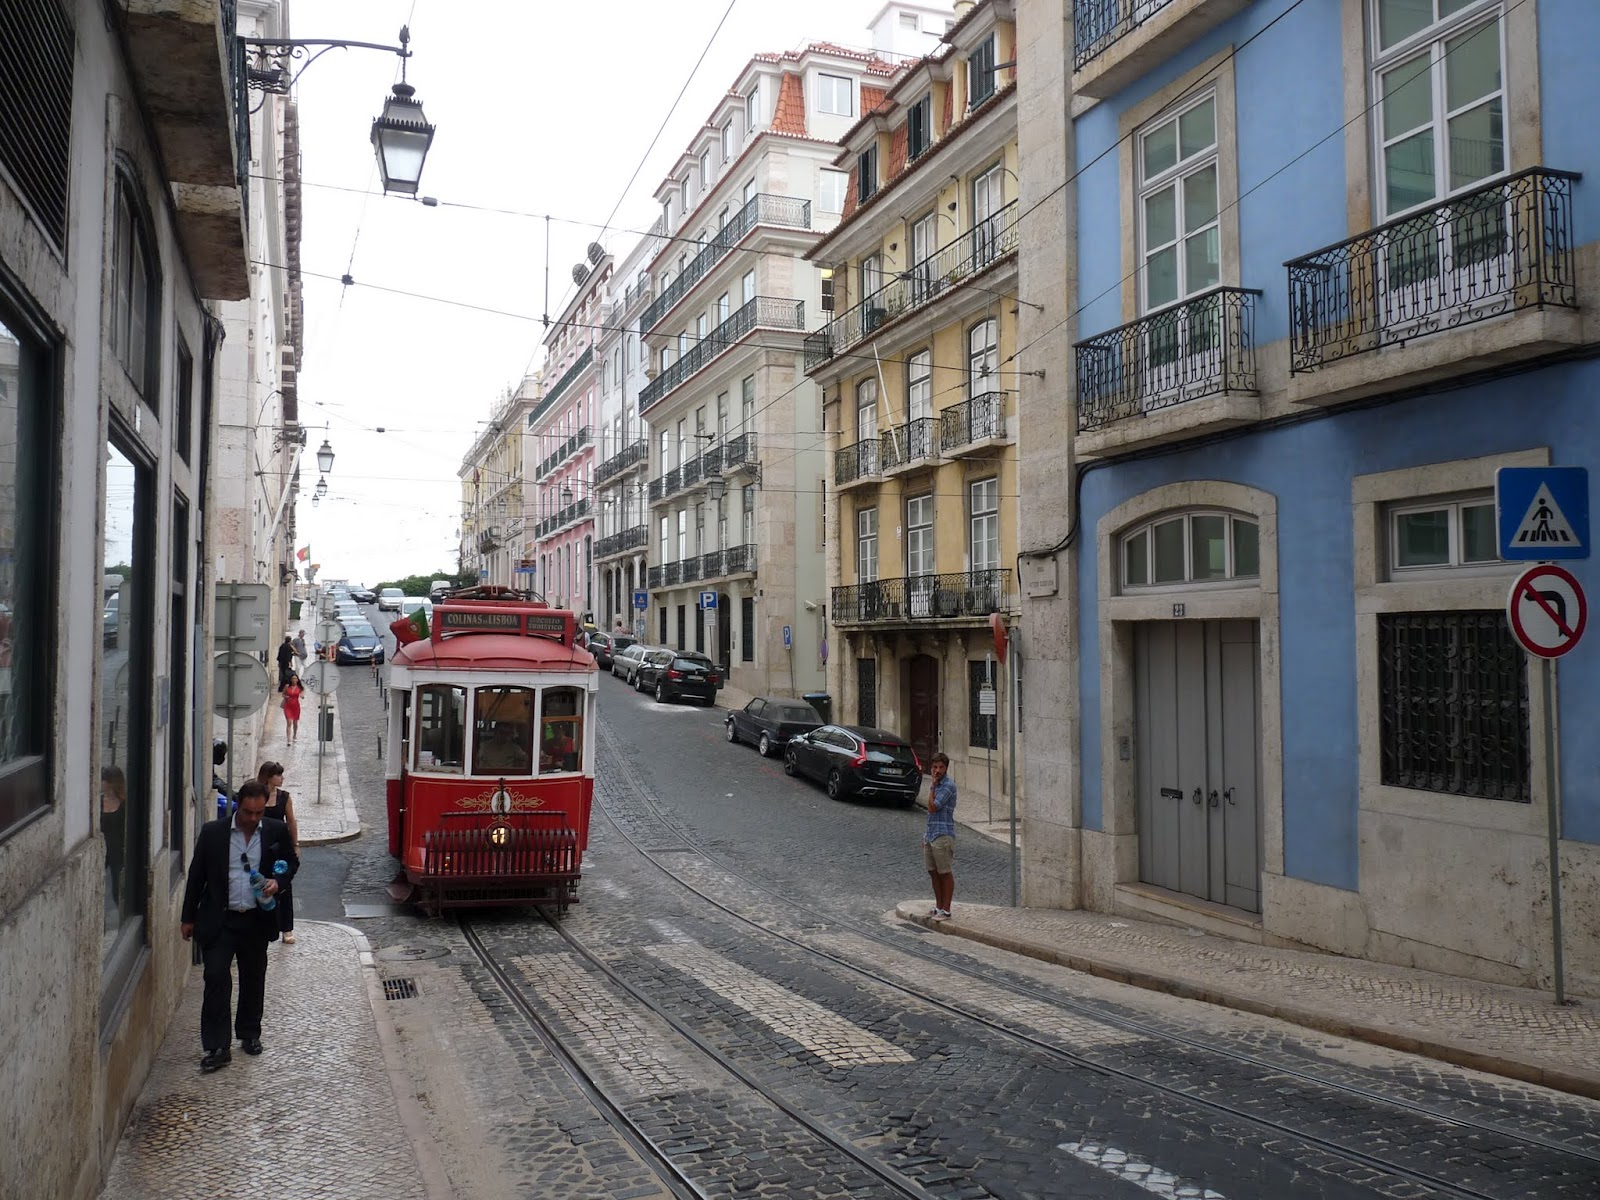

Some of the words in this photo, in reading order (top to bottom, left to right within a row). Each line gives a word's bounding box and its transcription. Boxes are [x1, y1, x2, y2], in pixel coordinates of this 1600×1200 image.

[703, 593, 714, 607] P
[448, 613, 483, 625] COLINAS
[488, 614, 518, 626] LISBOA
[784, 628, 789, 643] P
